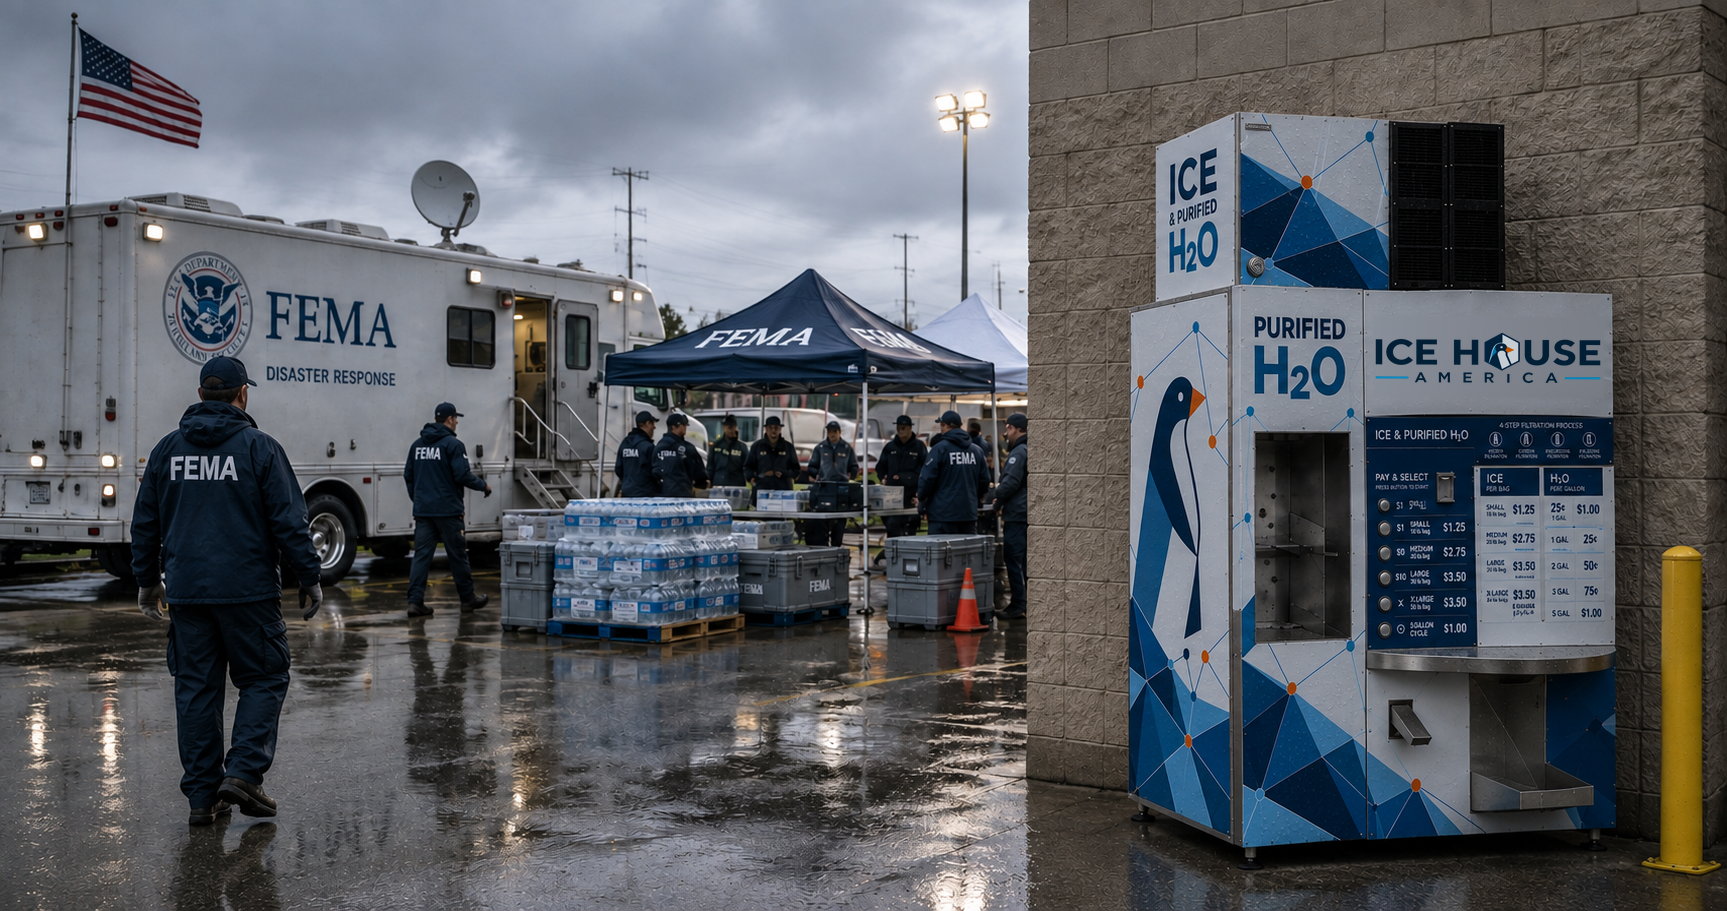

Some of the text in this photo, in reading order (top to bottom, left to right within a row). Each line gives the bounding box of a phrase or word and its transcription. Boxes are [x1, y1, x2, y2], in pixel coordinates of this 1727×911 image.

[1169, 147, 1217, 206] ICE
[1169, 198, 1217, 226] & PURIFIED
[1169, 220, 1219, 274] H2O
[266, 291, 397, 348] FEMA
[1254, 316, 1346, 340] PURIFIED
[694, 327, 814, 349] FEMA
[1375, 338, 1438, 366] ICE
[266, 366, 396, 387] DISASTER RESPONSE
[1254, 345, 1347, 400] H2O
[1414, 372, 1559, 384] AMERICA
[1375, 430, 1392, 440] ICE
[1393, 430, 1402, 440] &
[1404, 430, 1448, 441] PURIFIED
[414, 447, 441, 460] FEMA
[949, 451, 977, 466] FEMA
[170, 455, 239, 481] FEMA
[1375, 472, 1429, 481] PAY & SELECT
[1486, 473, 1504, 483] ICE
[1512, 504, 1535, 515] $1.25
[1551, 502, 1600, 515] 25¢ $1.00
[1443, 522, 1466, 533] $1.25
[1512, 533, 1536, 544] $2.75
[1583, 533, 1598, 544] 25¢
[1443, 546, 1467, 557] $2.75
[1512, 560, 1536, 571] $3.50
[1551, 562, 1556, 570] 2
[1583, 560, 1599, 571] 50¢
[1443, 571, 1467, 582] $3.50
[809, 579, 831, 593] FEMA
[1584, 585, 1599, 596] 75¢
[1512, 589, 1536, 600] $3.50
[1443, 596, 1467, 608] $3.50
[1581, 607, 1603, 618] $1.00
[1443, 622, 1467, 633] $1.00
